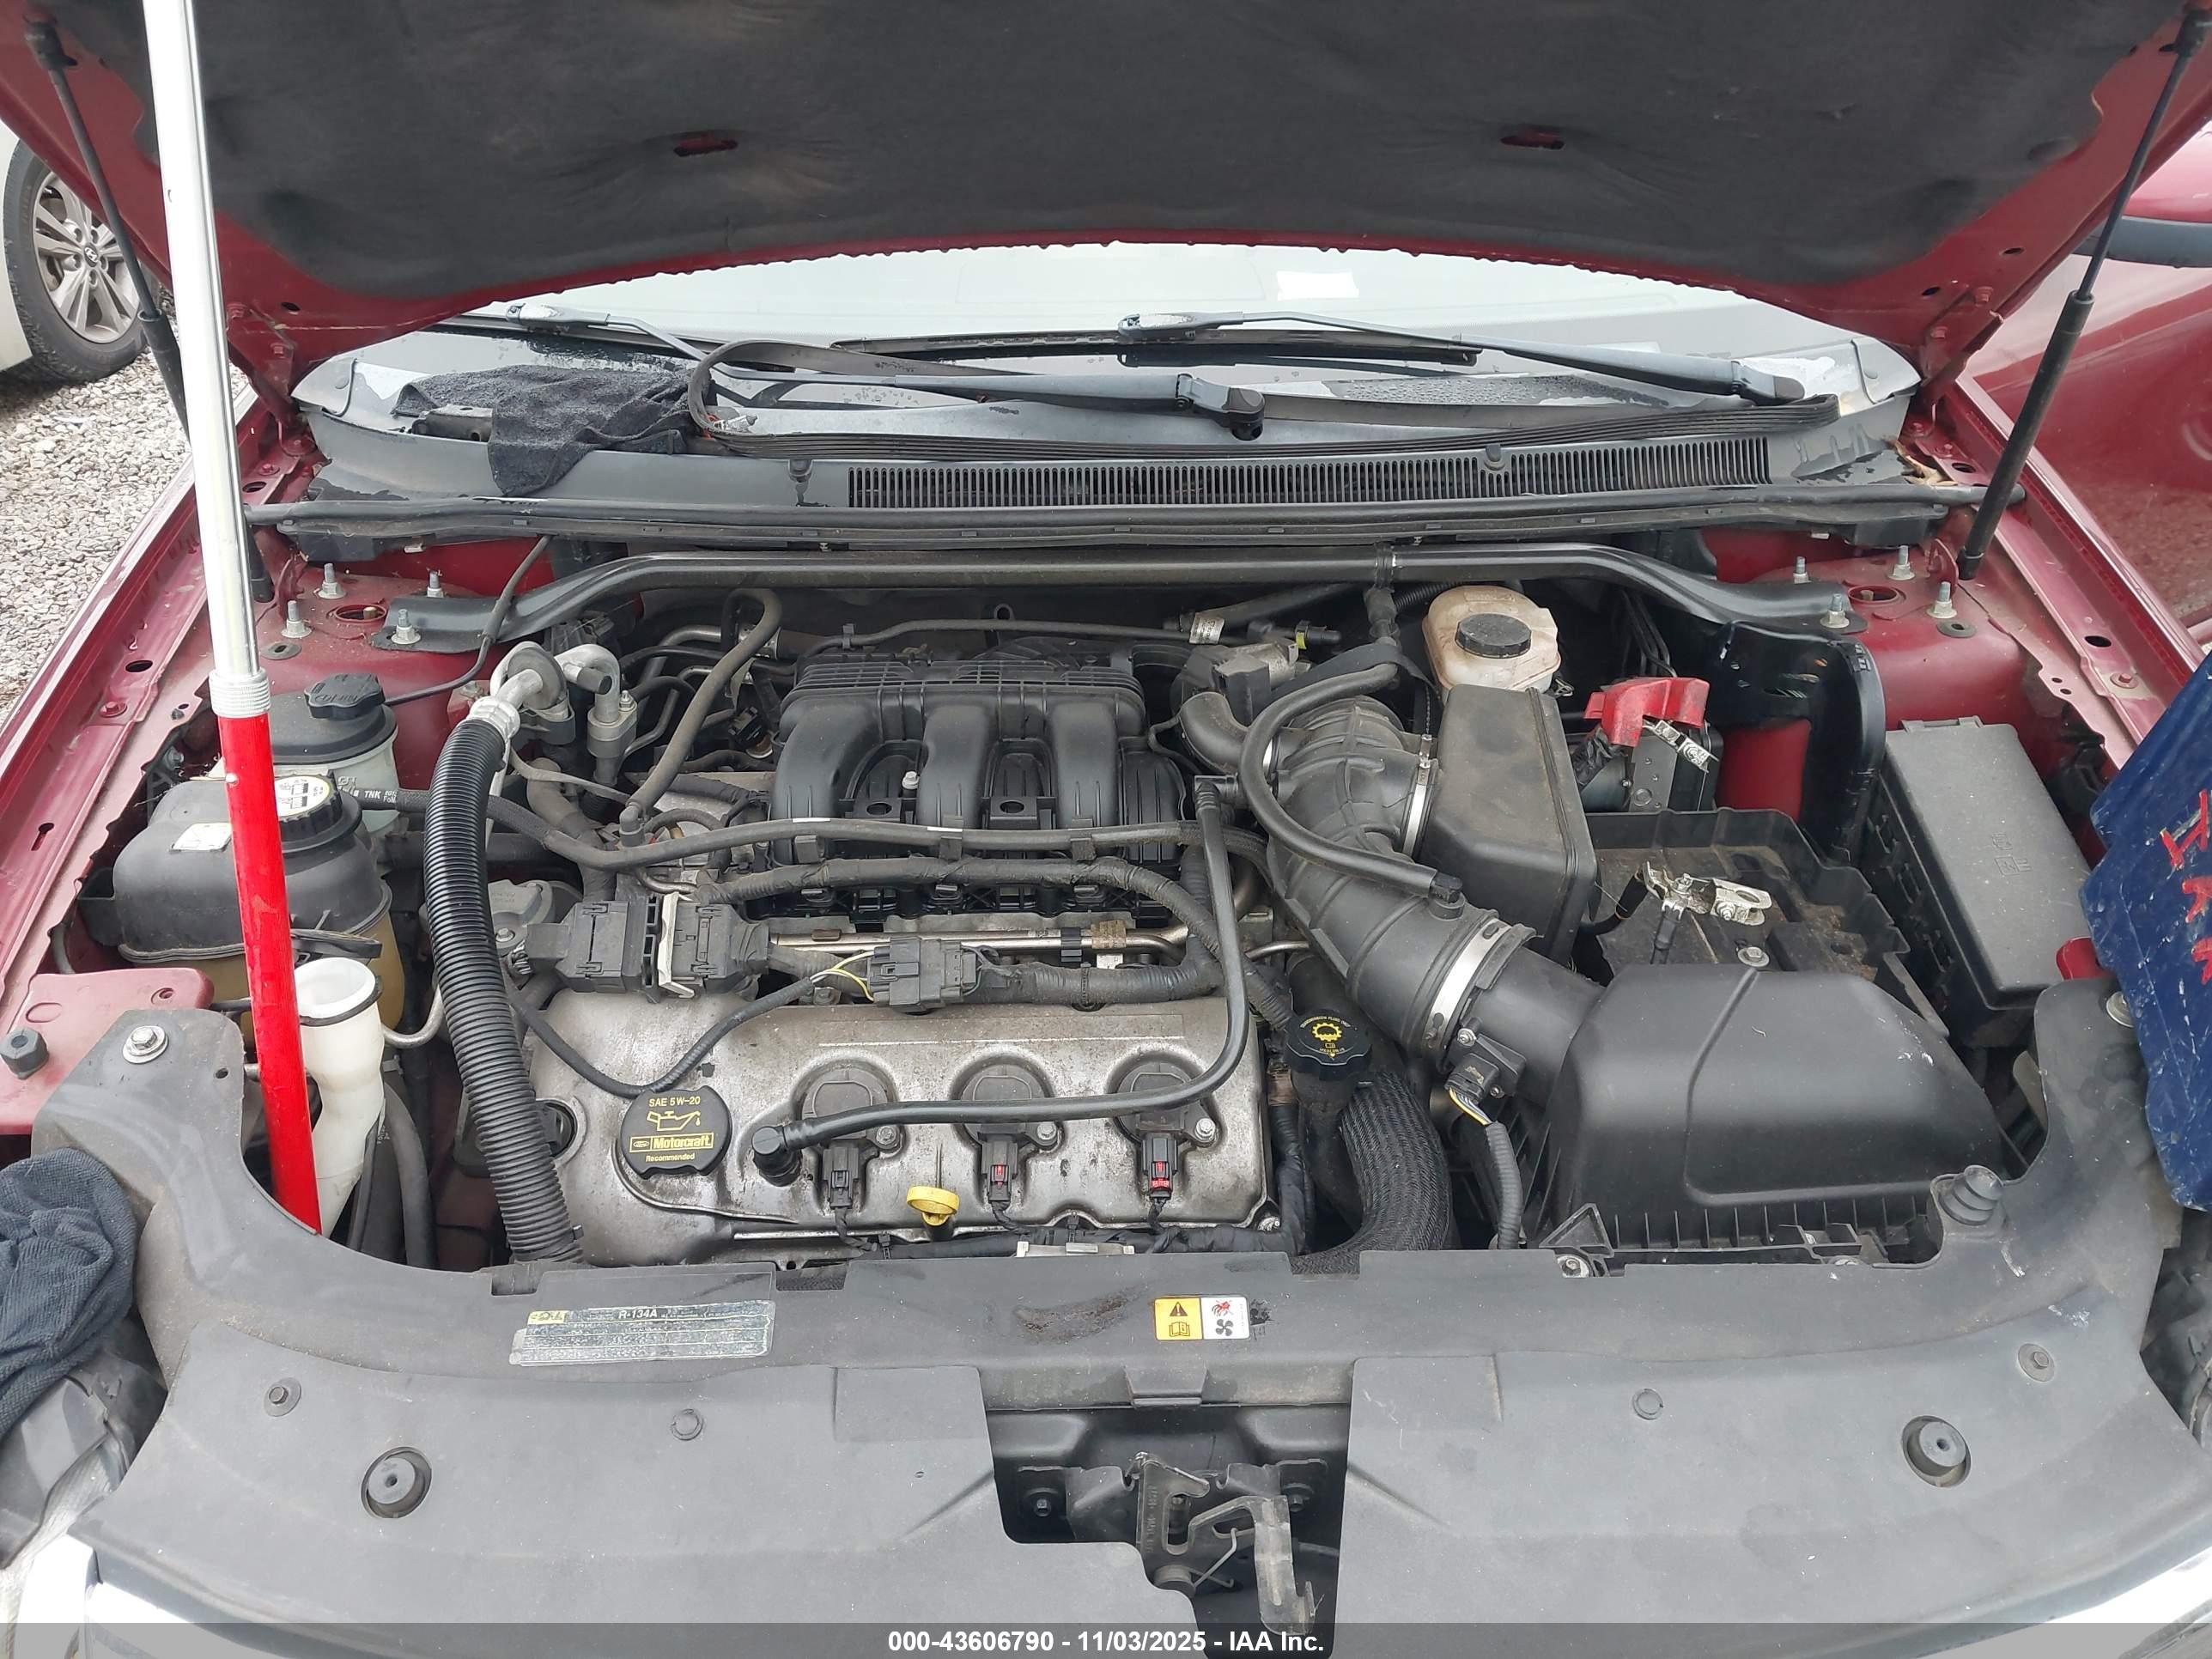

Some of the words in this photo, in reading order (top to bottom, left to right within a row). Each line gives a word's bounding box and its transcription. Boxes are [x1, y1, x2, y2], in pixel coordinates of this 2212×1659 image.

[648, 1098, 667, 1107] SAE
[670, 1096, 701, 1106] 5W-20
[653, 1135, 711, 1149] Motorcraft
[646, 1152, 696, 1163] Recommended
[617, 1309, 657, 1320] R-134A
